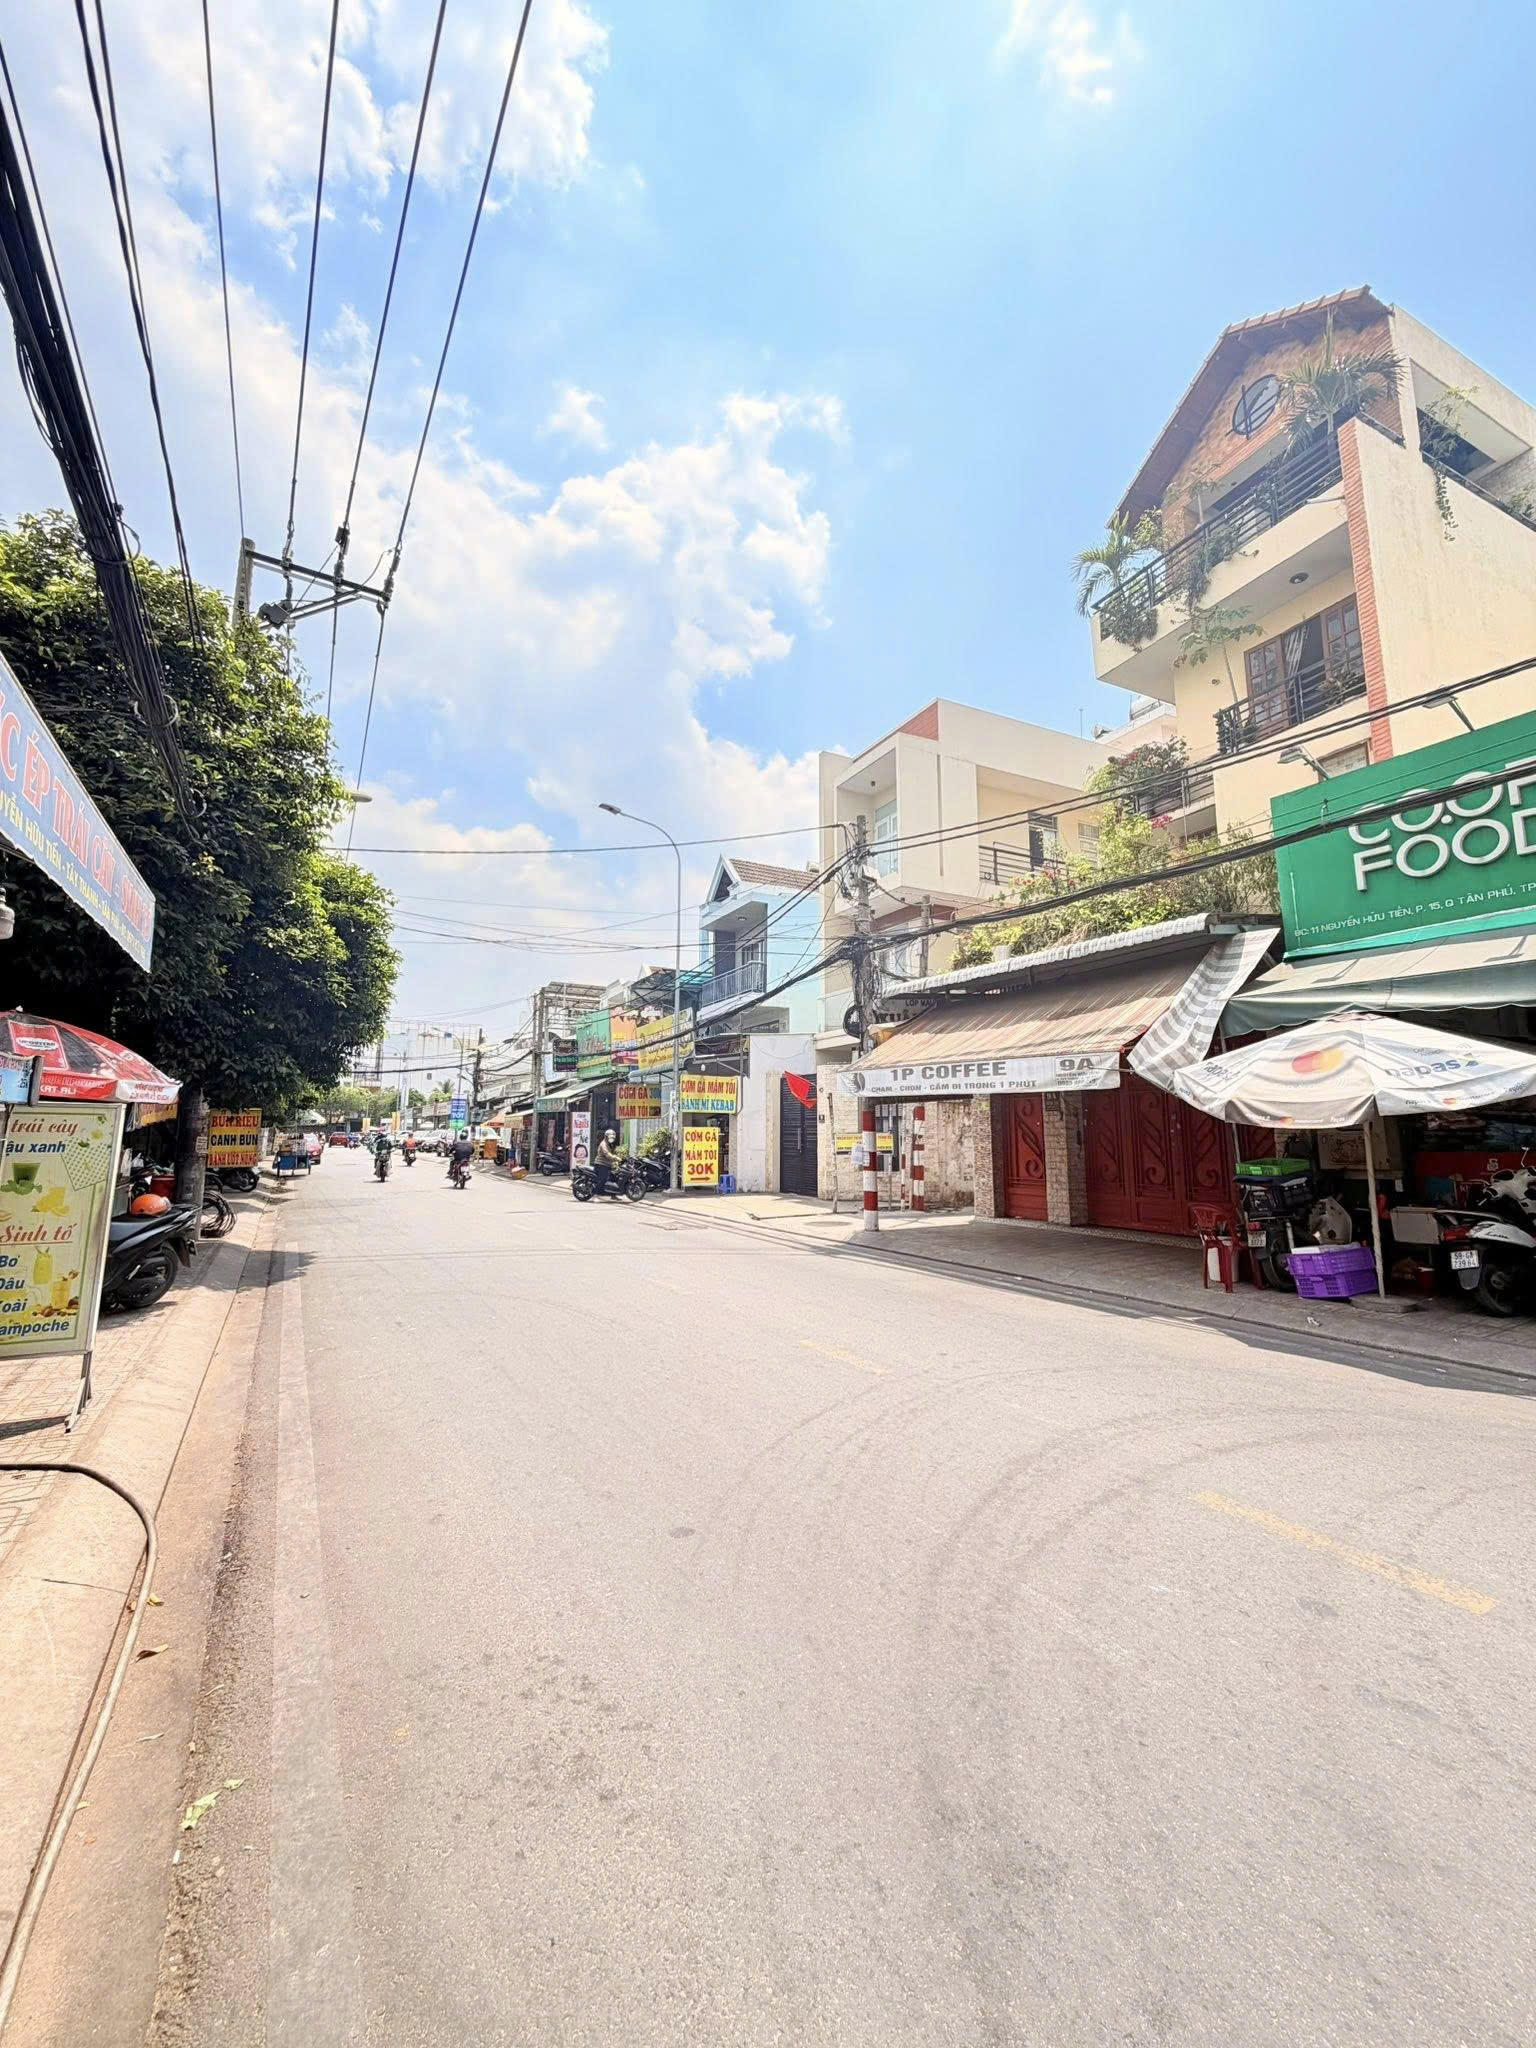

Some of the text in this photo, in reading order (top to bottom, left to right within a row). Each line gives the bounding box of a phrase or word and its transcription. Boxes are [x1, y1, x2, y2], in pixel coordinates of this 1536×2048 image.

[1444, 898, 1455, 908] Q
[889, 1061, 1007, 1082] 1P COFFEE
[1059, 1057, 1094, 1072] 9A
[964, 1081, 996, 1090] TRONG
[711, 1099, 734, 1111] KEBAB
[11, 1118, 79, 1136] trái cây
[210, 1134, 237, 1146] CANH
[239, 1130, 258, 1146] BÚN
[28, 1140, 66, 1153] xanh
[687, 1163, 714, 1175] 30K
[0, 1223, 78, 1243] Sinh tố
[0, 1299, 28, 1313] oài
[0, 1319, 70, 1337] ampoche
